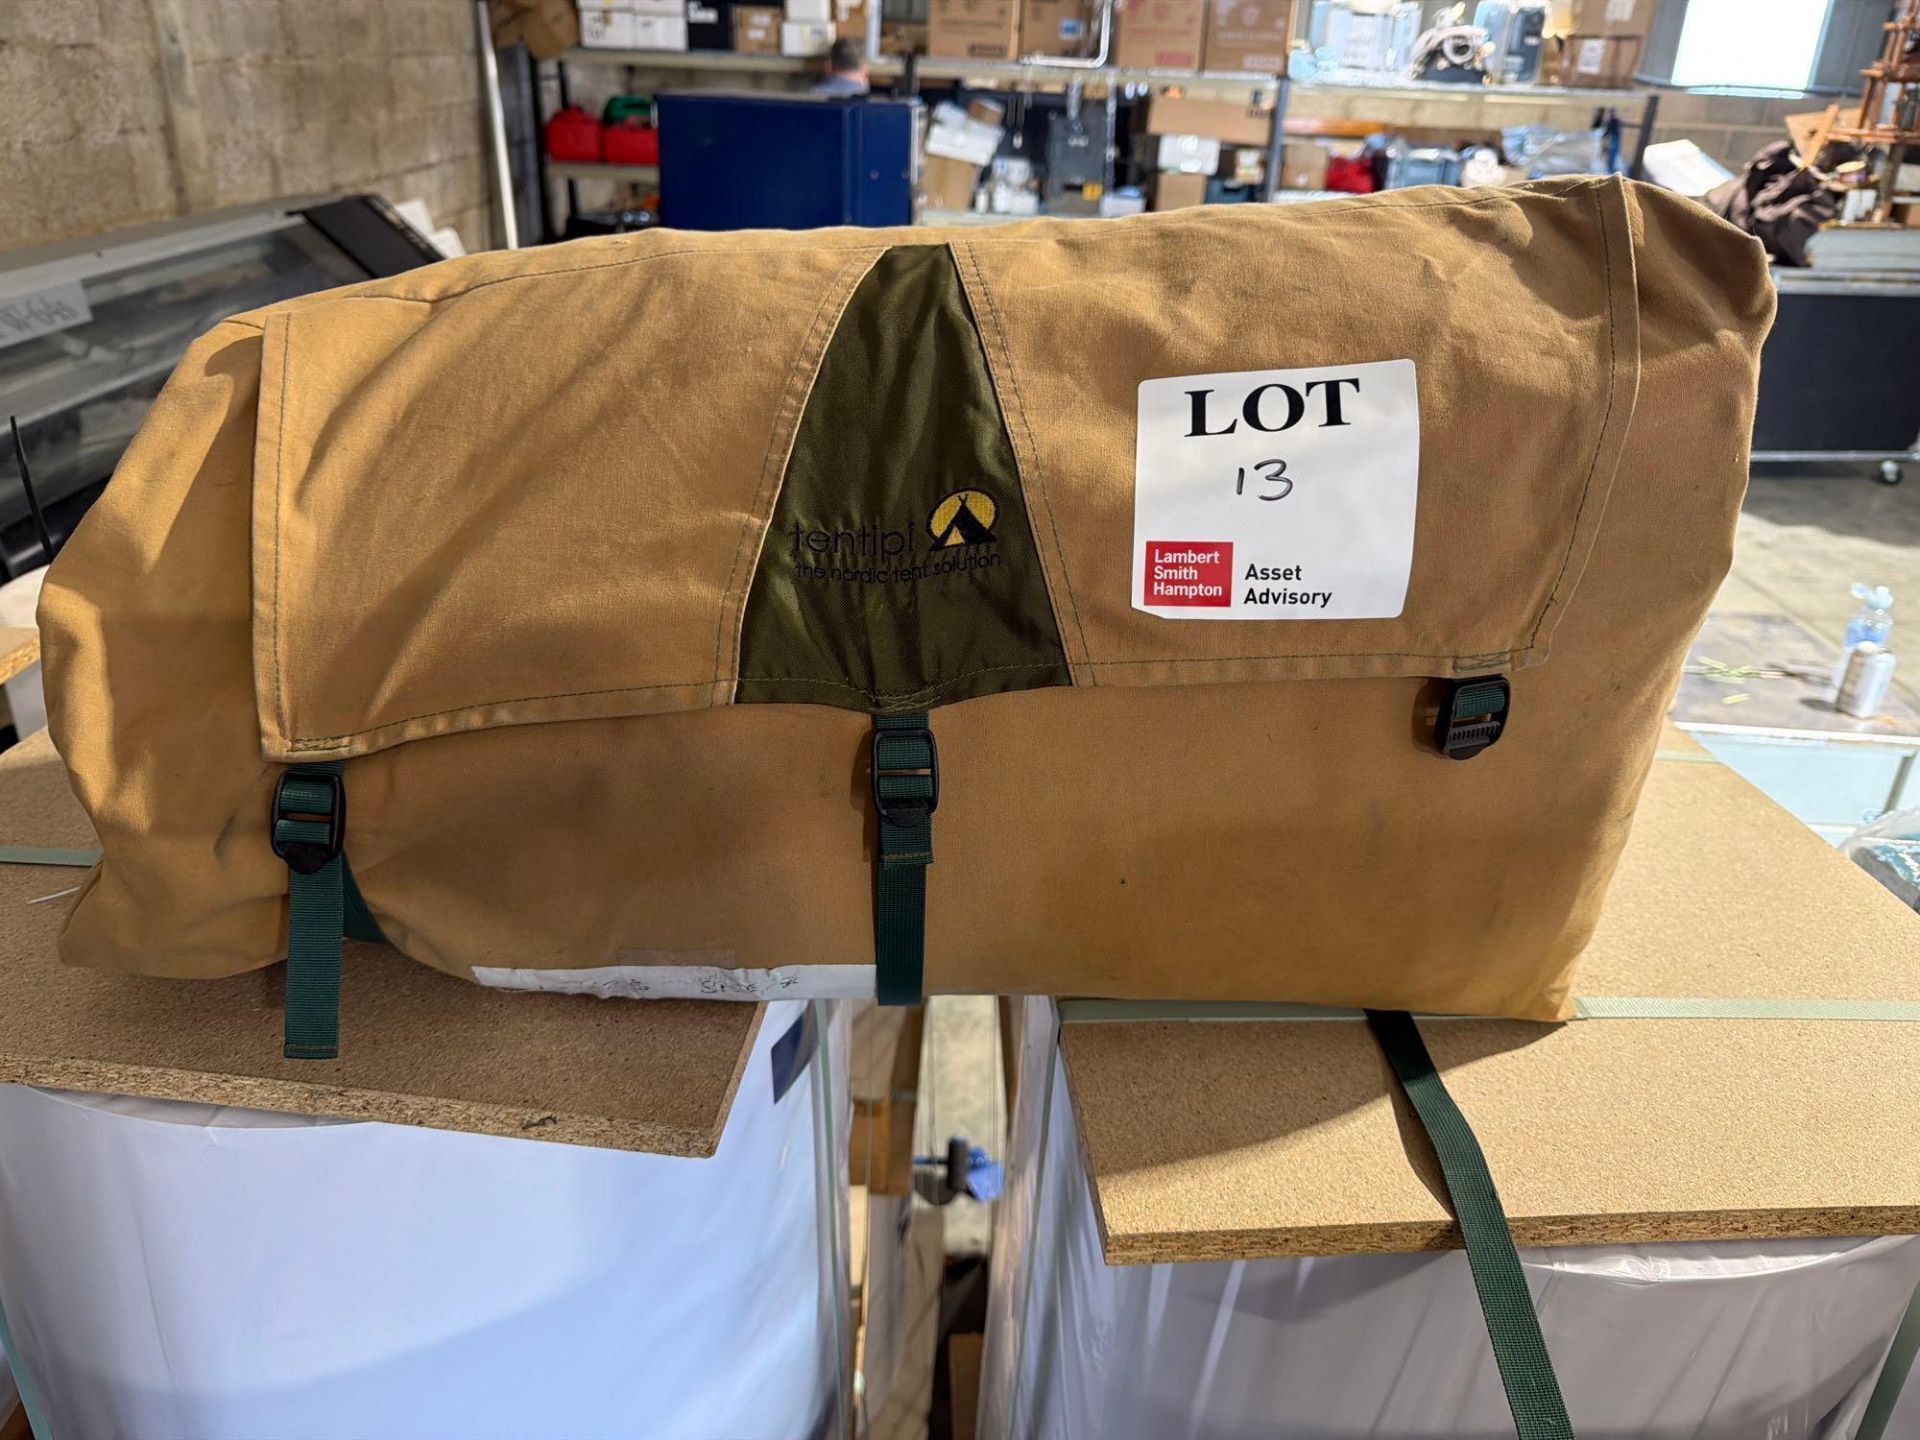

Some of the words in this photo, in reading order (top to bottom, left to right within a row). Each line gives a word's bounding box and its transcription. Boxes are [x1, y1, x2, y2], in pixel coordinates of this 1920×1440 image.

[1184, 377, 1361, 437] LOT
[1236, 458, 1294, 502] 13
[789, 521, 916, 563] tentipi
[1154, 549, 1220, 564] Lambert
[795, 562, 826, 579] the
[831, 565, 889, 584] nordic
[893, 564, 929, 583] tent
[933, 551, 1001, 577] solution
[1153, 565, 1199, 580] Smith
[1244, 563, 1302, 581] Asset
[1153, 581, 1223, 599] Hampton
[1243, 587, 1333, 608] Advisory
